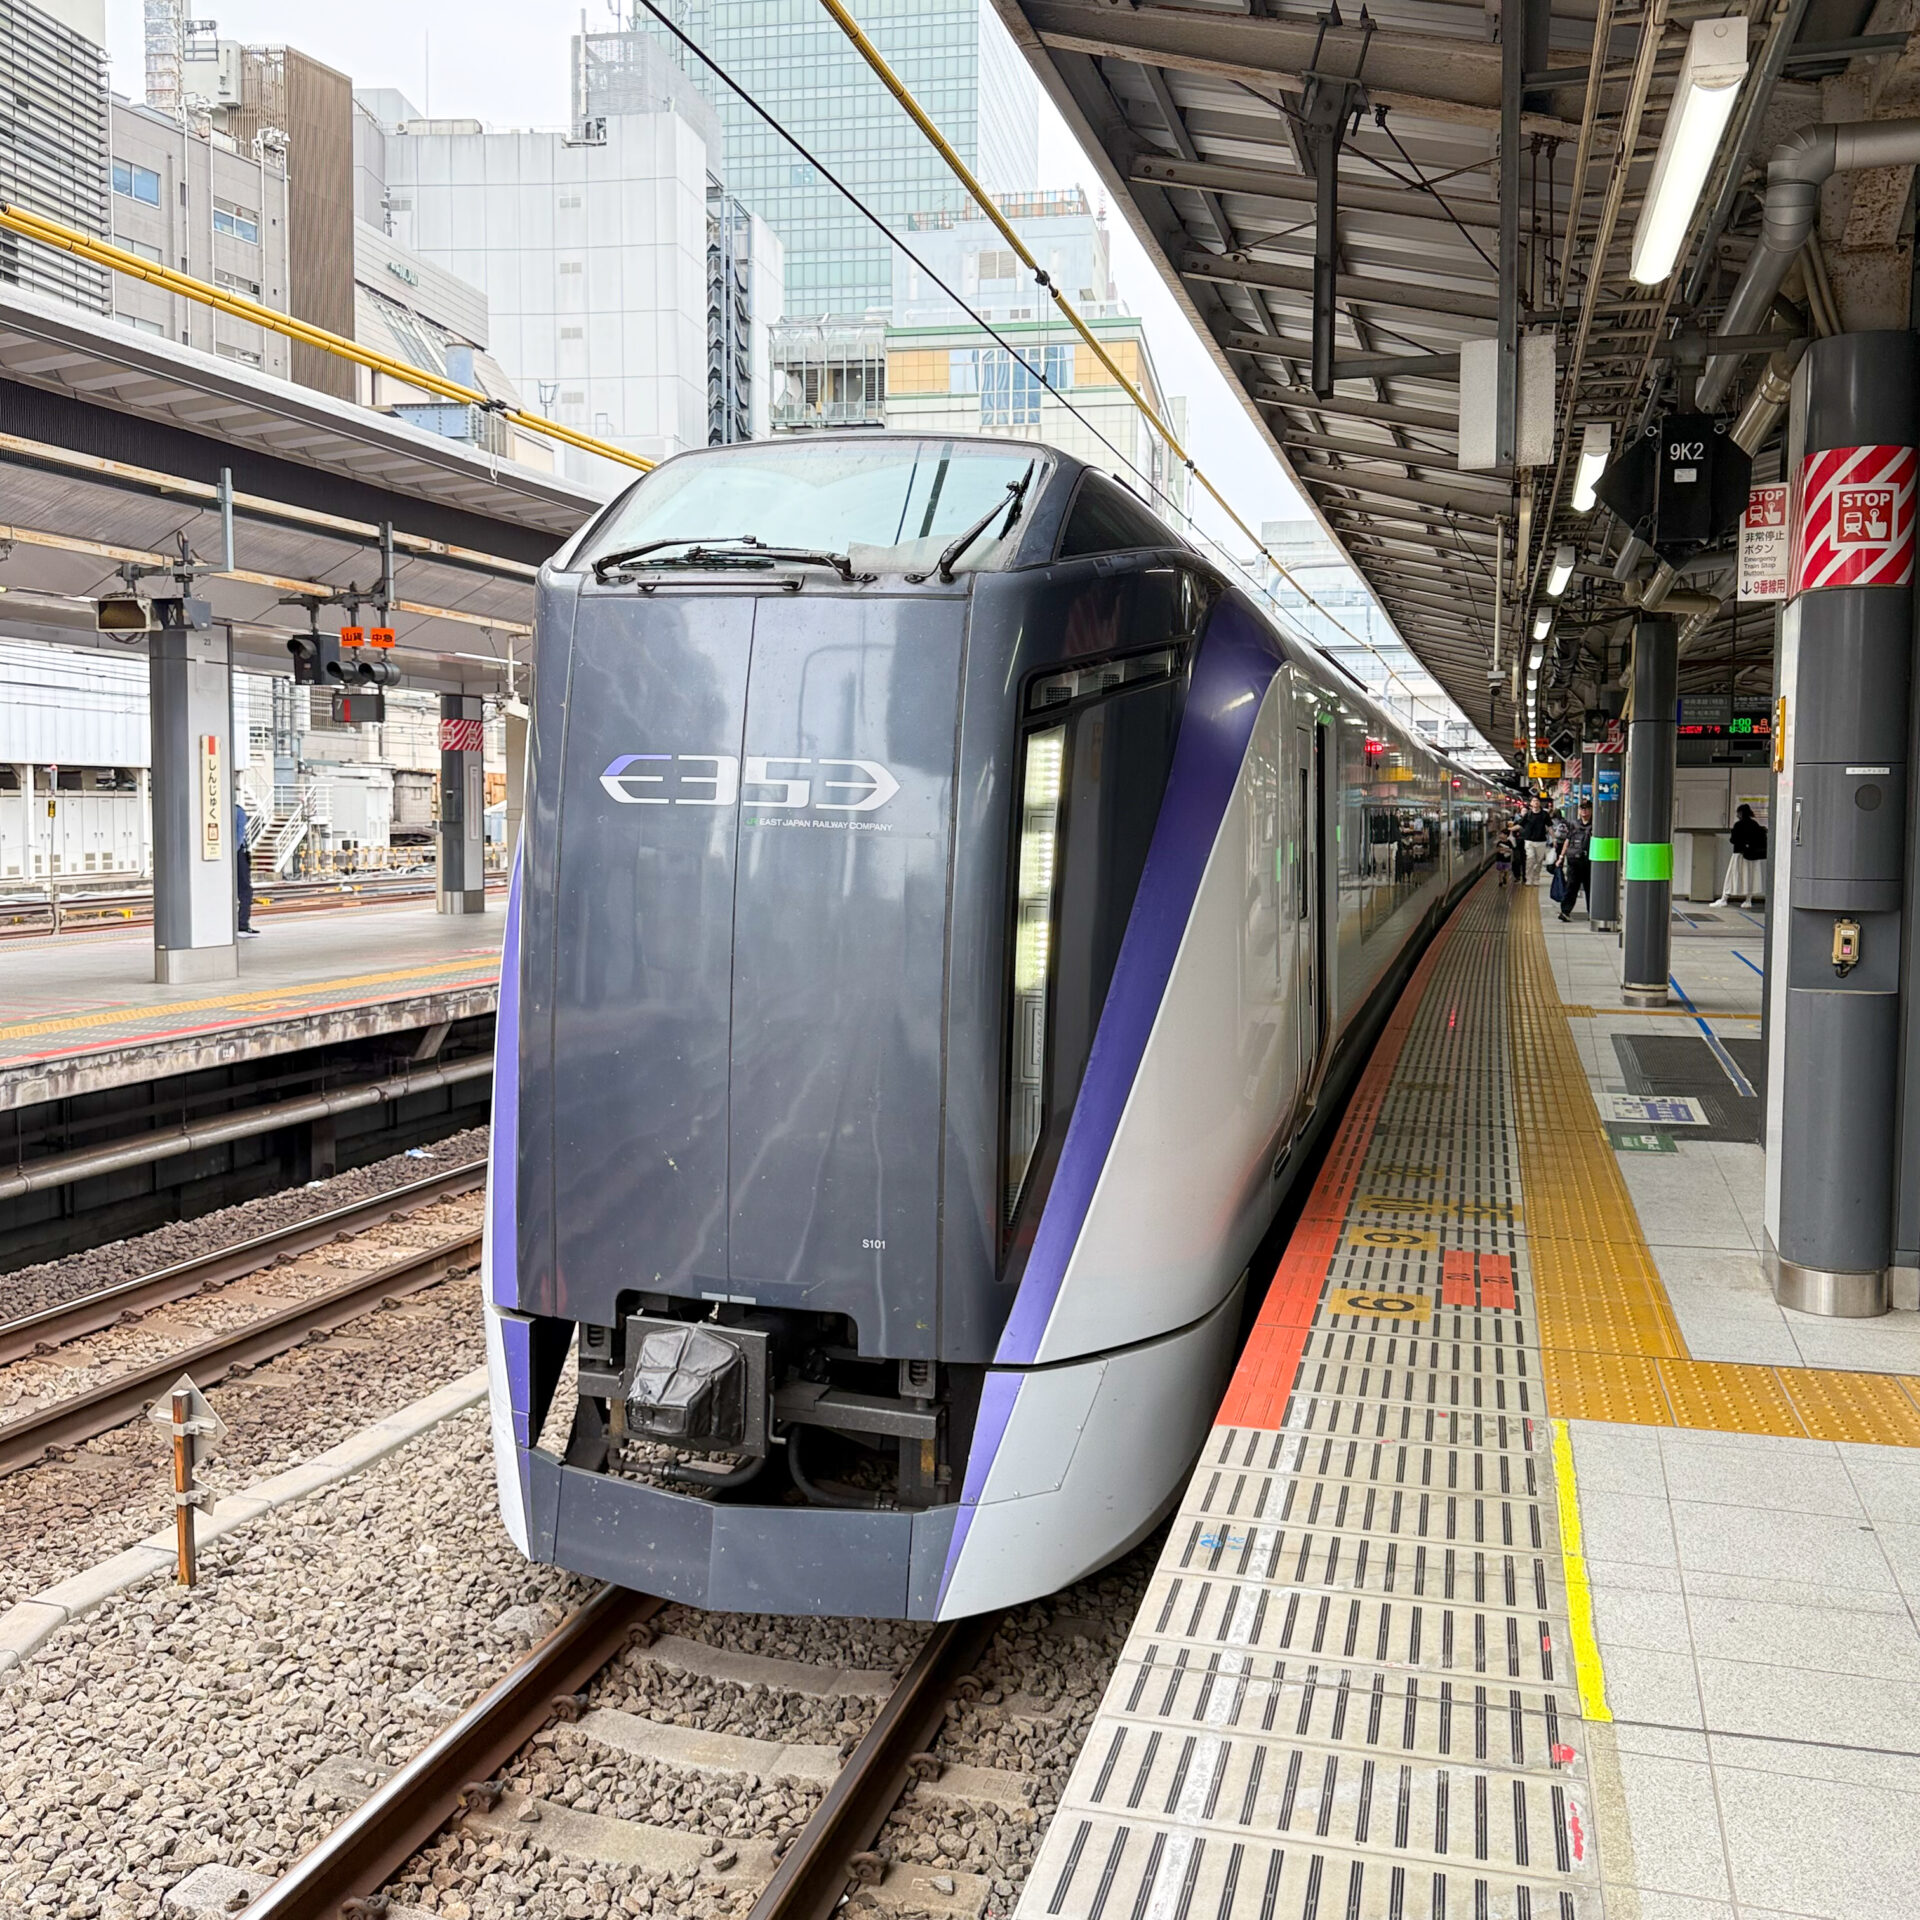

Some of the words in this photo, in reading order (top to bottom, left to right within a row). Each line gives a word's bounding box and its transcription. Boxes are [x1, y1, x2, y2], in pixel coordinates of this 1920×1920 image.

[1670, 442, 1704, 460] 9K2
[1749, 490, 1784, 502] STOP
[1842, 492, 1891, 508] STOP
[1745, 531, 1785, 543] 非常停止
[1744, 544, 1774, 556] ボタン
[1753, 579, 1786, 595] 9番線用
[208, 759, 217, 820] しんじゅく
[599, 754, 901, 812] E353
[760, 818, 782, 827] EAST
[782, 820, 811, 828] JAPAN
[812, 820, 849, 829] RAILWAY
[849, 822, 893, 832] COMPANY
[862, 1238, 886, 1250] S101
